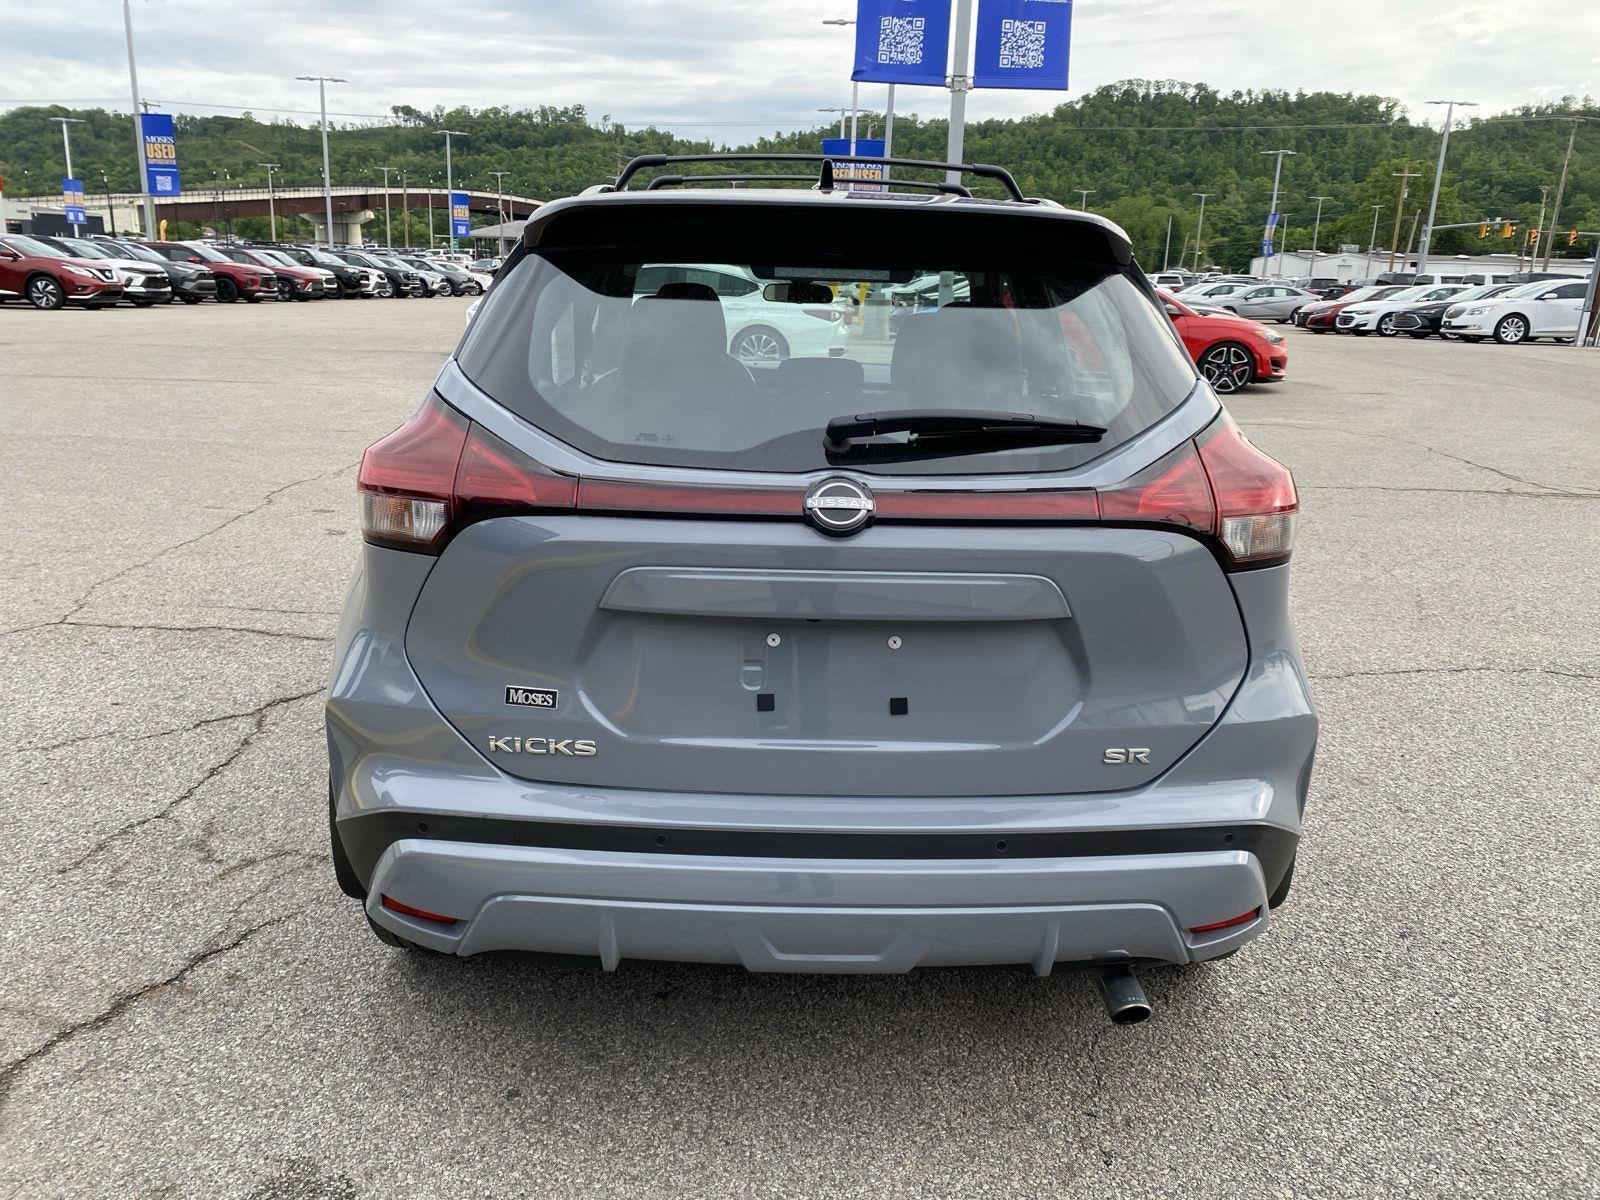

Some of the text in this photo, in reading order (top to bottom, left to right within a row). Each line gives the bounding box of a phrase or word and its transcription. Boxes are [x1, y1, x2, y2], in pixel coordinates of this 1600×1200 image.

[145, 135, 174, 143] MOSES
[146, 143, 176, 159] USED
[854, 169, 881, 180] USED
[808, 498, 871, 507] NISSAN
[508, 688, 553, 706] MOSES
[488, 735, 597, 756] KICKS
[1103, 748, 1151, 764] SR
